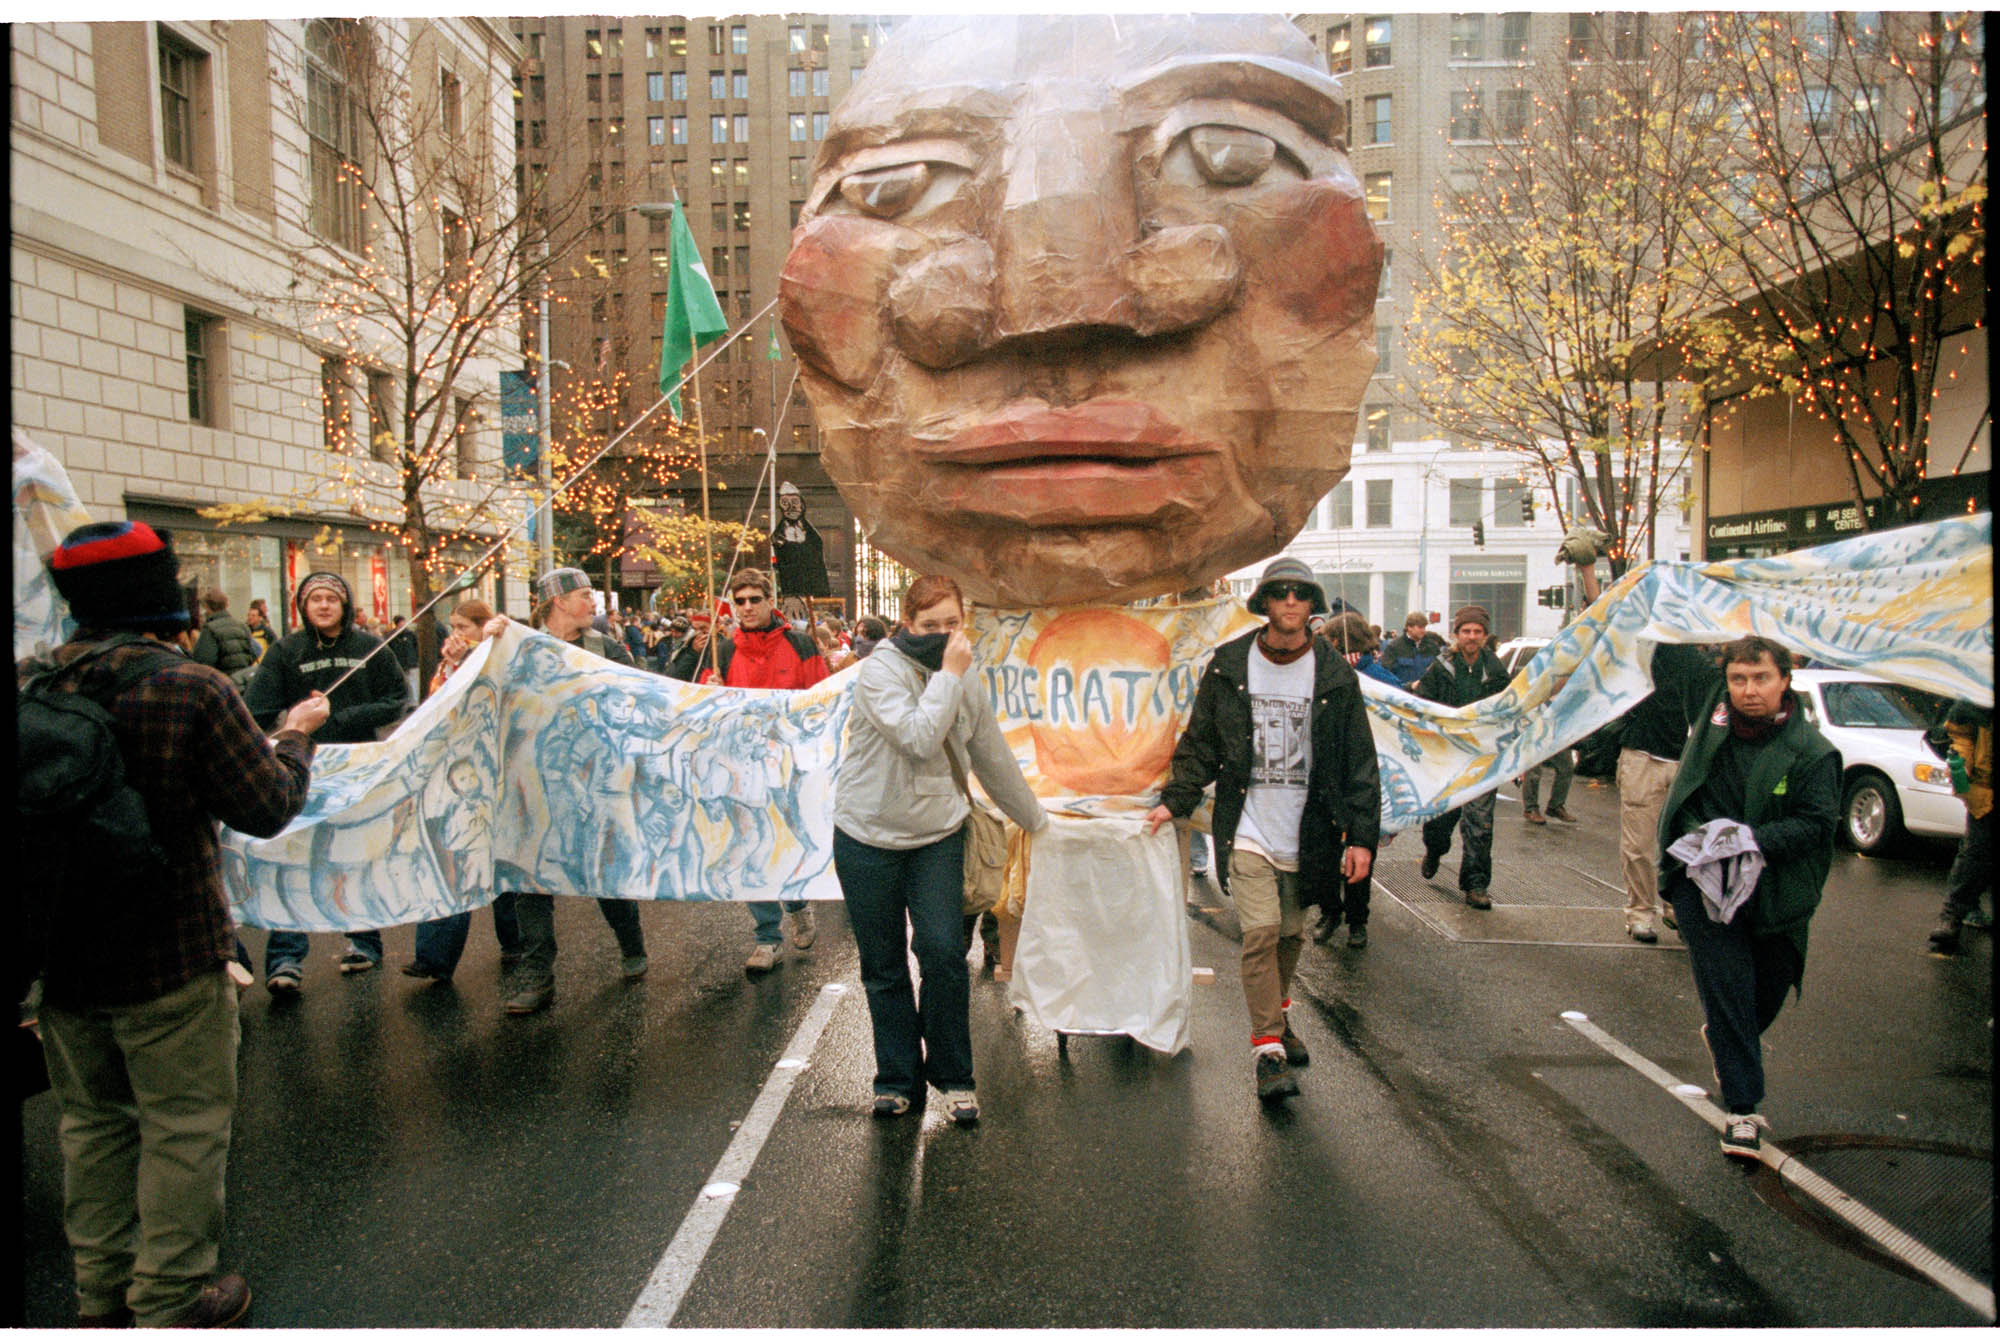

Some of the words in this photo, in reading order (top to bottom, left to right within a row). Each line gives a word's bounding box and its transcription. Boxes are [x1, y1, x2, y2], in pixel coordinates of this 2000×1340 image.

[1827, 510, 1840, 521] AIR
[1841, 505, 1875, 520] SERE
[1708, 520, 1753, 539] Continental
[1753, 518, 1787, 535] Airlines
[1834, 519, 1862, 531] CENTE
[986, 663, 1204, 725] IBERATIO
